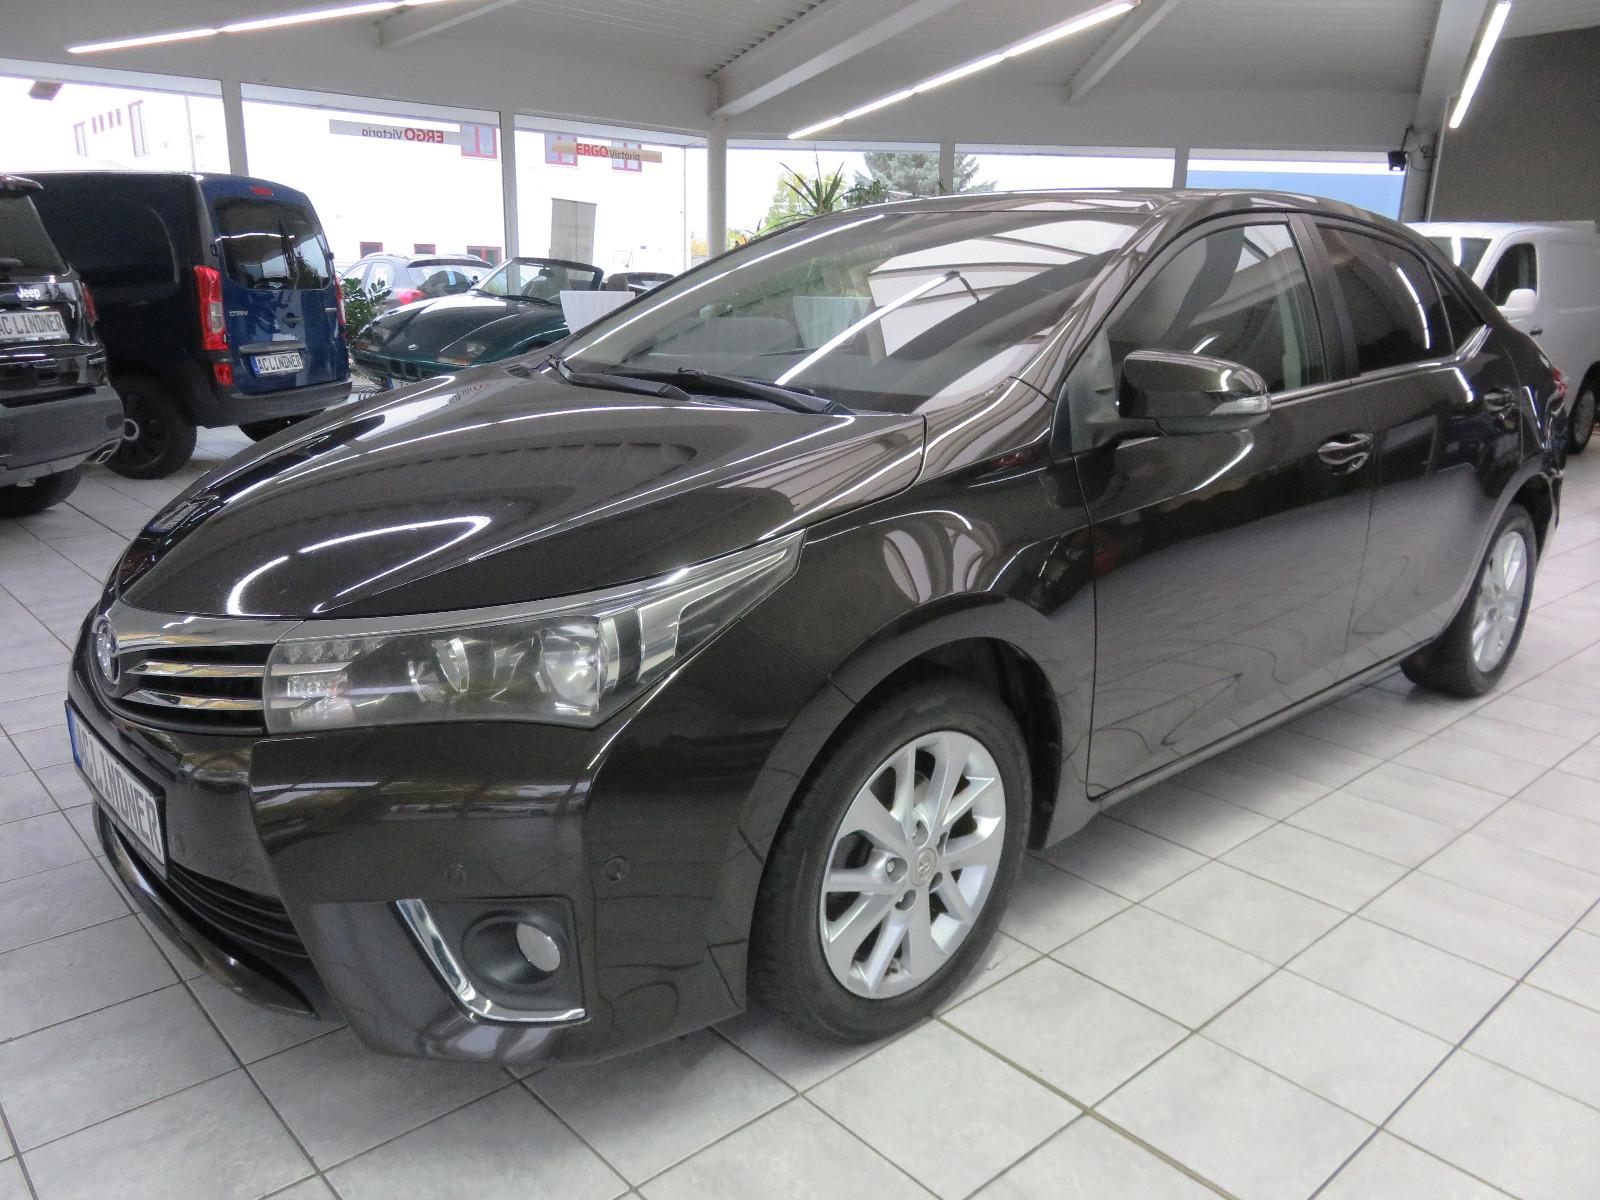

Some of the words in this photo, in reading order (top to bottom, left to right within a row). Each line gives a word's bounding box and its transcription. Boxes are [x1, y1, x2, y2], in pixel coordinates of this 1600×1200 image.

[576, 143, 609, 158] ERGO
[609, 150, 640, 161] Victoria
[17, 286, 41, 299] Jeep
